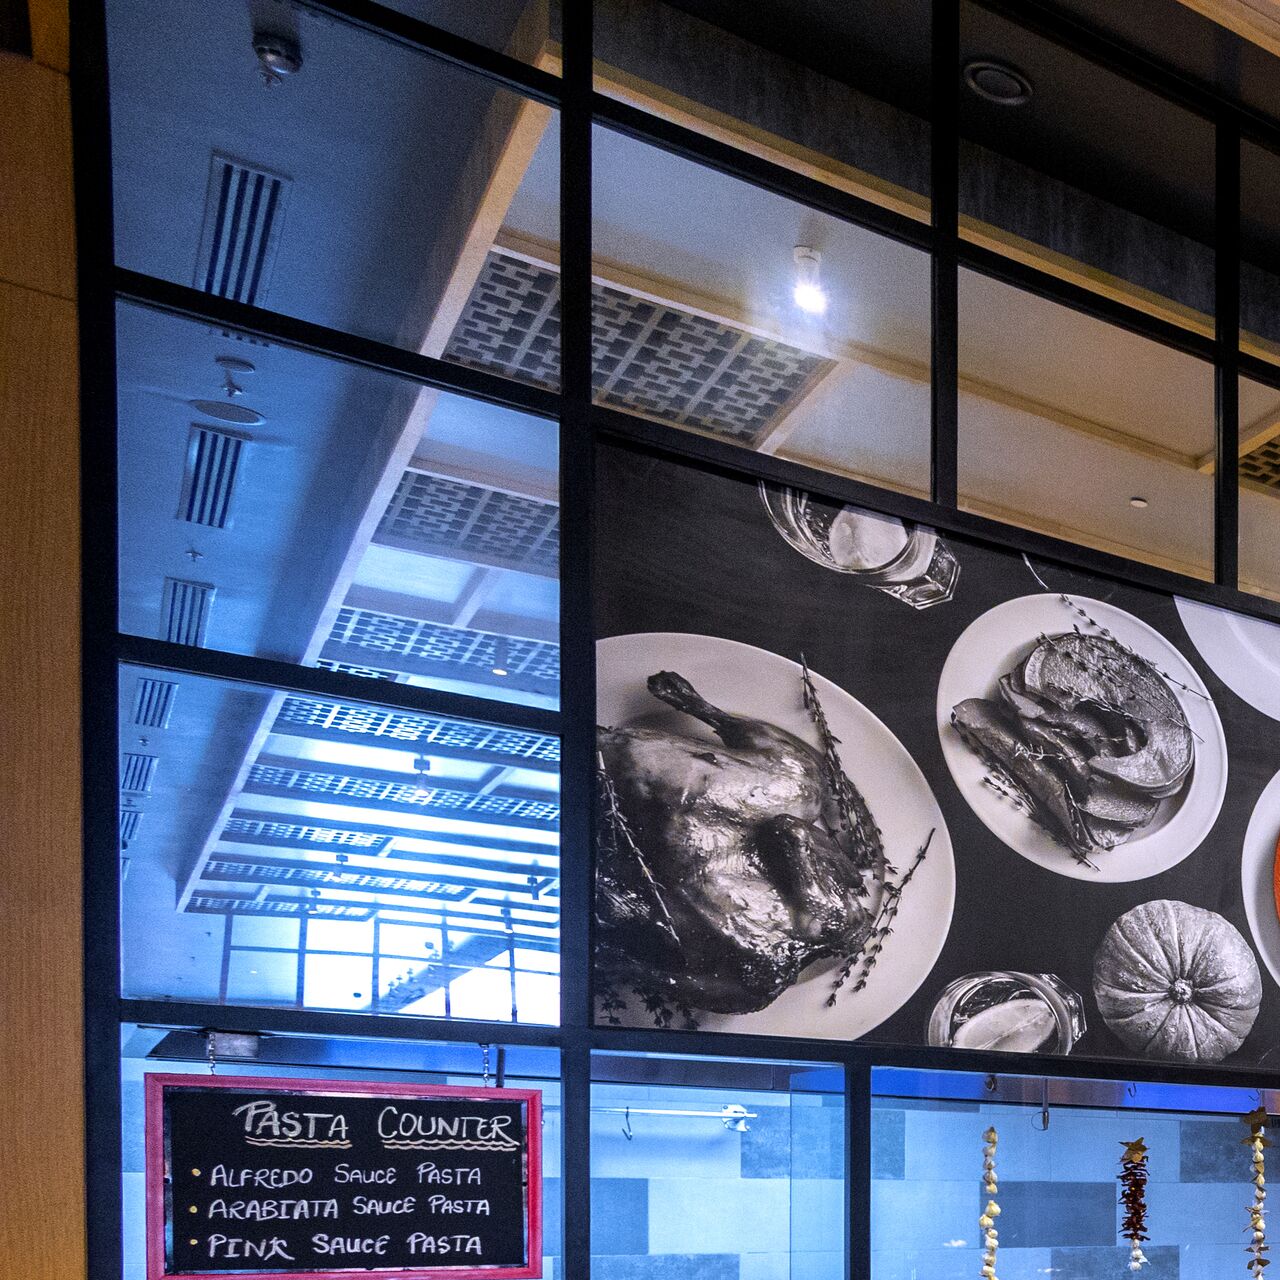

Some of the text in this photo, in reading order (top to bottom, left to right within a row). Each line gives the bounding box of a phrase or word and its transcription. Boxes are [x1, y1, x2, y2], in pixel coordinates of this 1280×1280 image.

[232, 1101, 520, 1145] PASTA COUNTER
[211, 1162, 480, 1189] ALFREDO SAUCE PASTA
[208, 1195, 489, 1221] ARABIATA SAUCE PASTA
[208, 1232, 482, 1260] PINK SAUCE PASTA
